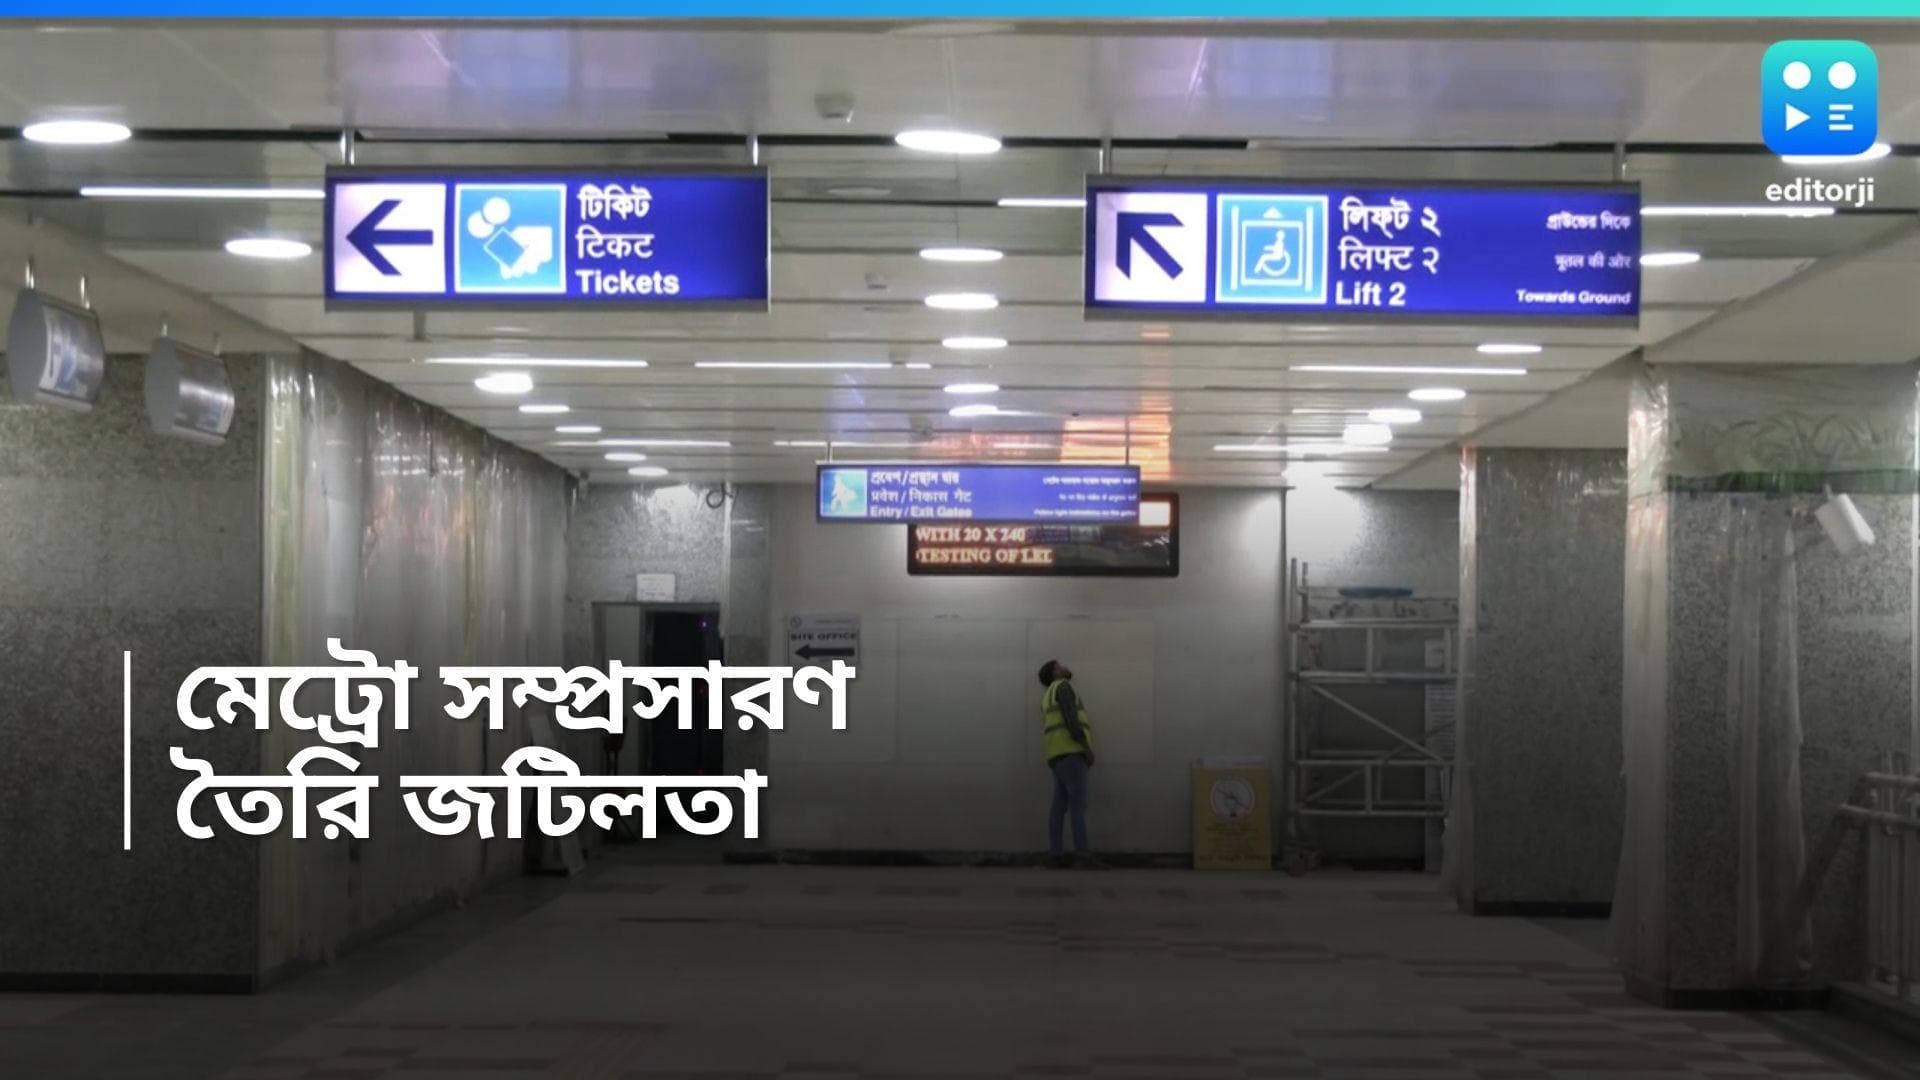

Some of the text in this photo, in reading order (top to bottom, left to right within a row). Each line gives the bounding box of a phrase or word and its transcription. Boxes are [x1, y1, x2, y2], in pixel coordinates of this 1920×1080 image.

[577, 182, 653, 221] টিকিট
[1420, 206, 1441, 237] ২
[575, 224, 655, 259] टिकट
[1338, 236, 1440, 274] लिफ्ट २
[575, 269, 680, 295] Tickets
[1335, 280, 1406, 306] Lift 2
[1516, 289, 1632, 304] Towards Ground
[870, 505, 902, 519] Entry
[915, 527, 1026, 541] WITH 20 X 240
[995, 548, 1019, 563] OF
[817, 632, 857, 641] OFFICE
